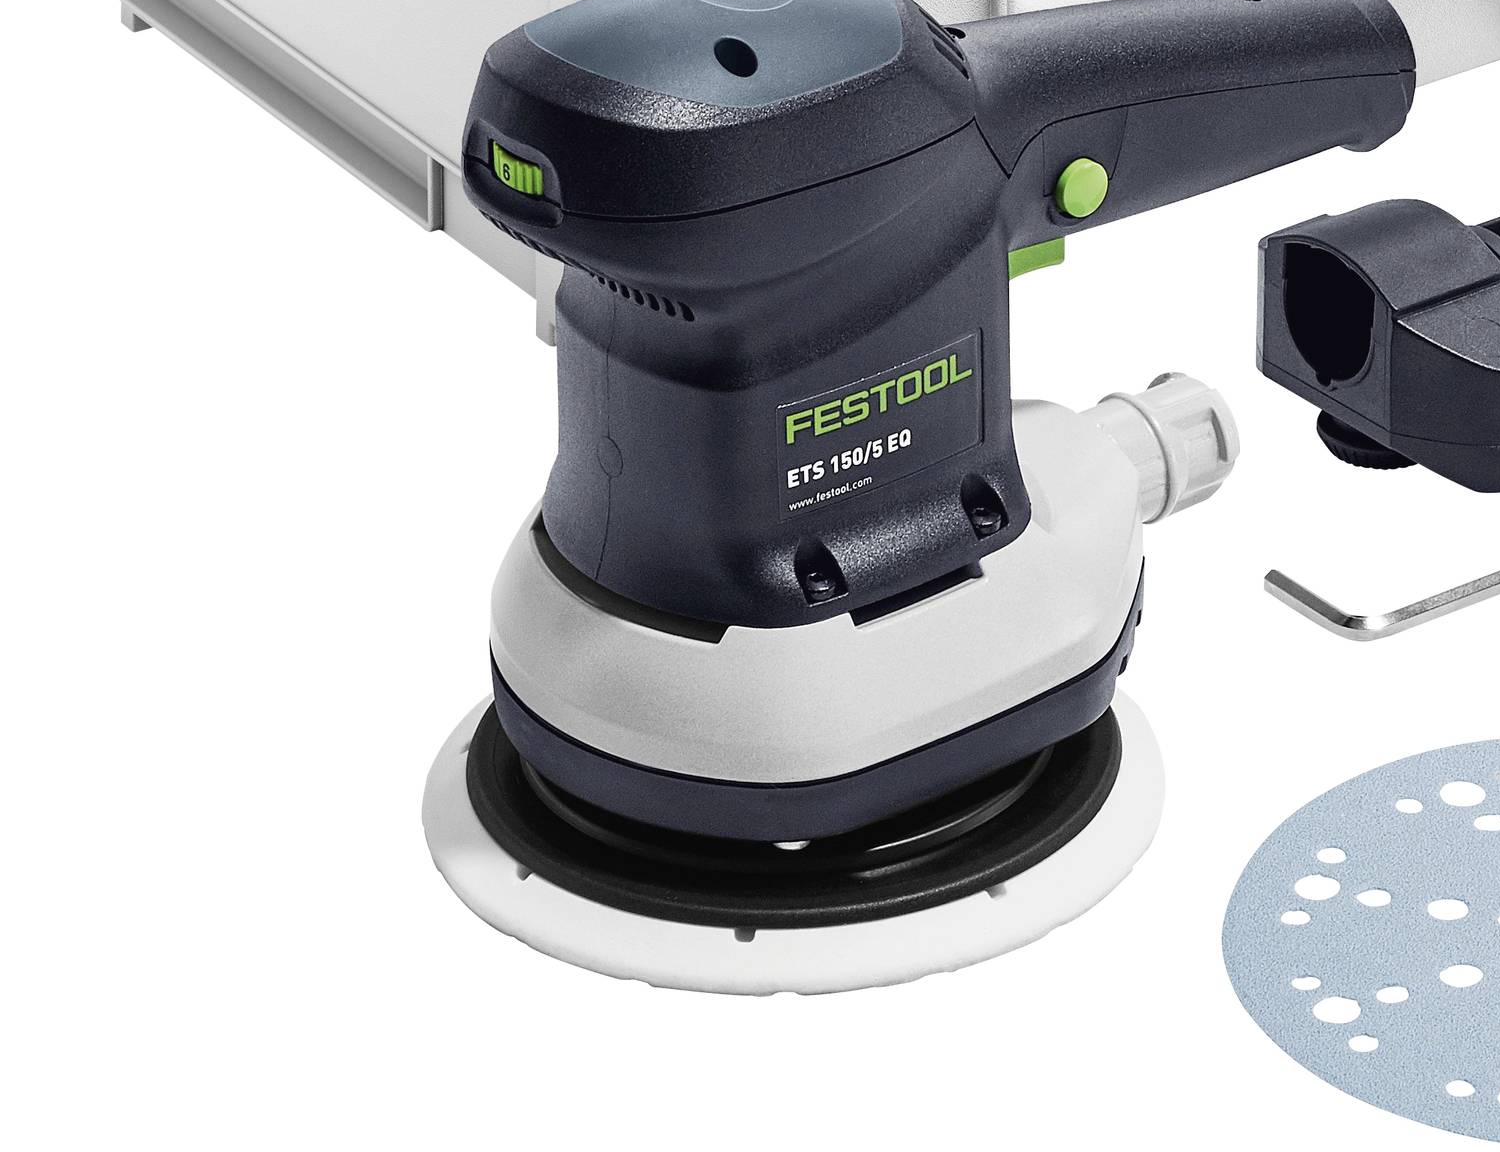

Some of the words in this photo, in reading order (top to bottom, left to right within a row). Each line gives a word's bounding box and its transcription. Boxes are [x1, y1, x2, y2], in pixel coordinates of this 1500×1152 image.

[502, 163, 511, 181] 6
[785, 354, 973, 445] FESTOOL
[787, 460, 825, 489] ETS
[829, 438, 883, 475] 150/5
[887, 429, 912, 455] EQ
[788, 475, 873, 511] www.festool.com
